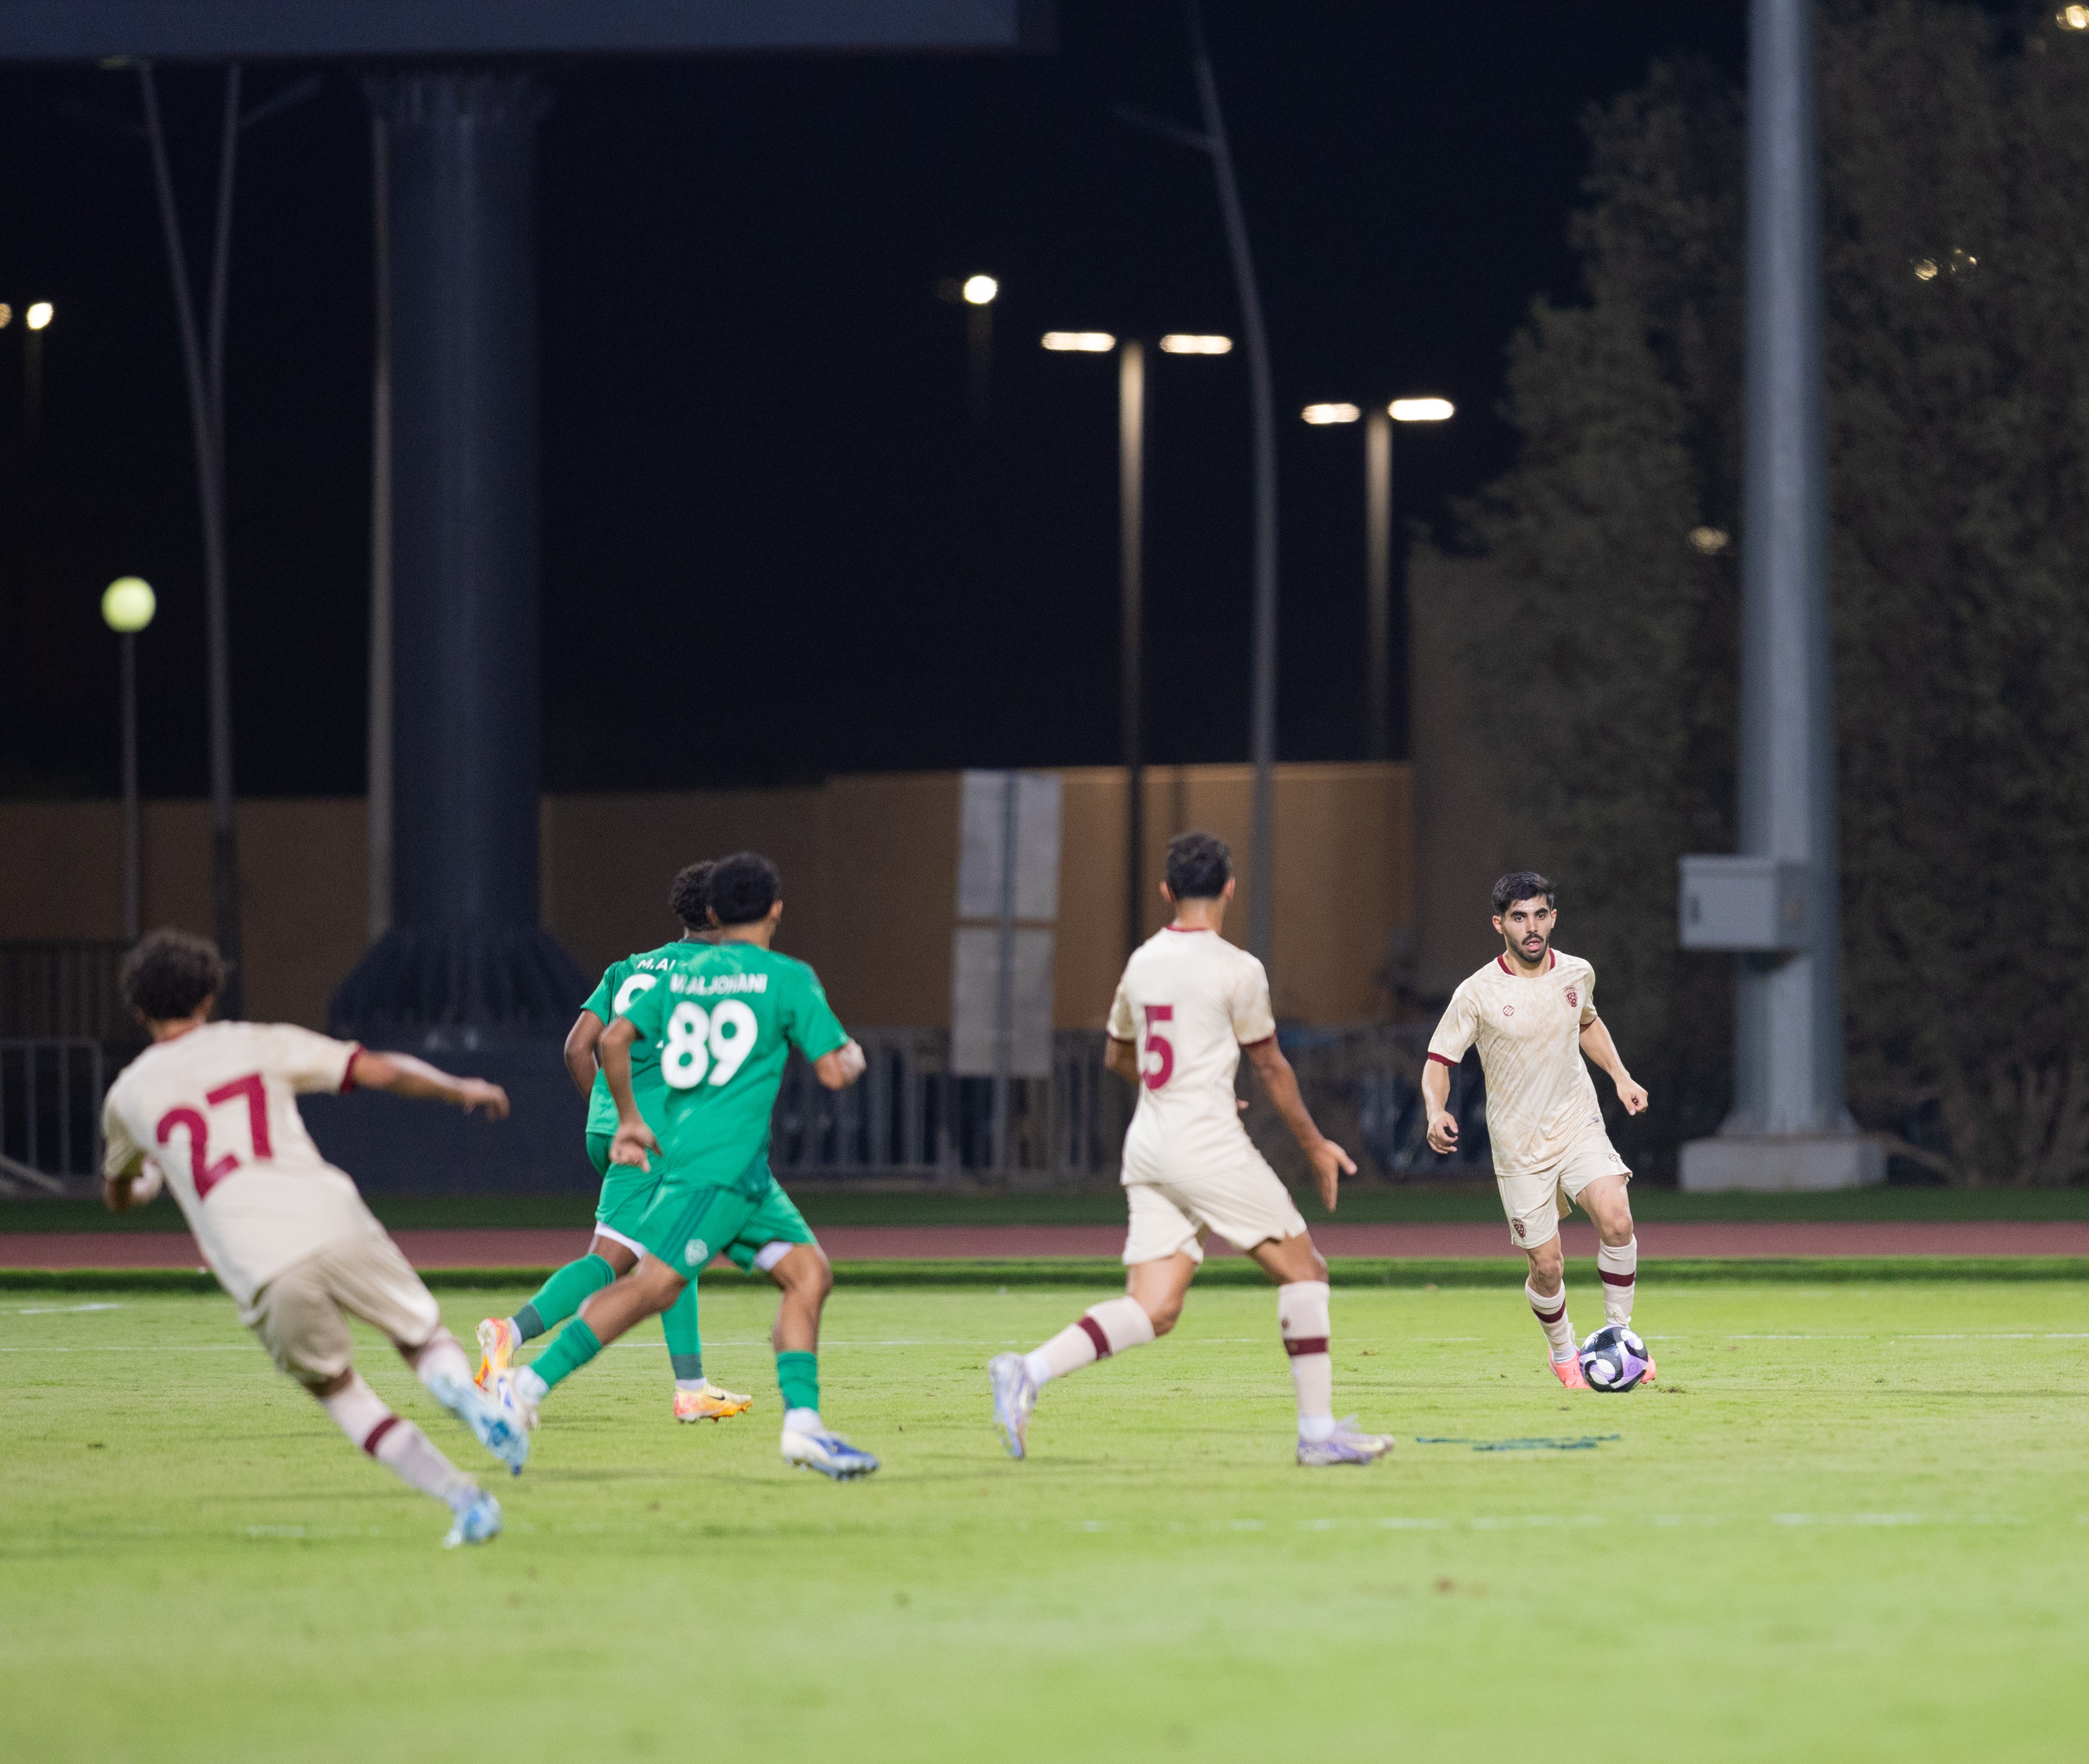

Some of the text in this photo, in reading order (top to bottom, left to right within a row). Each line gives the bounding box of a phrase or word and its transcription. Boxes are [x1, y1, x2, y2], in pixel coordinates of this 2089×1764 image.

[661, 1000, 758, 1090] 89
[1142, 1004, 1173, 1090] 5
[157, 1072, 272, 1201] 27
